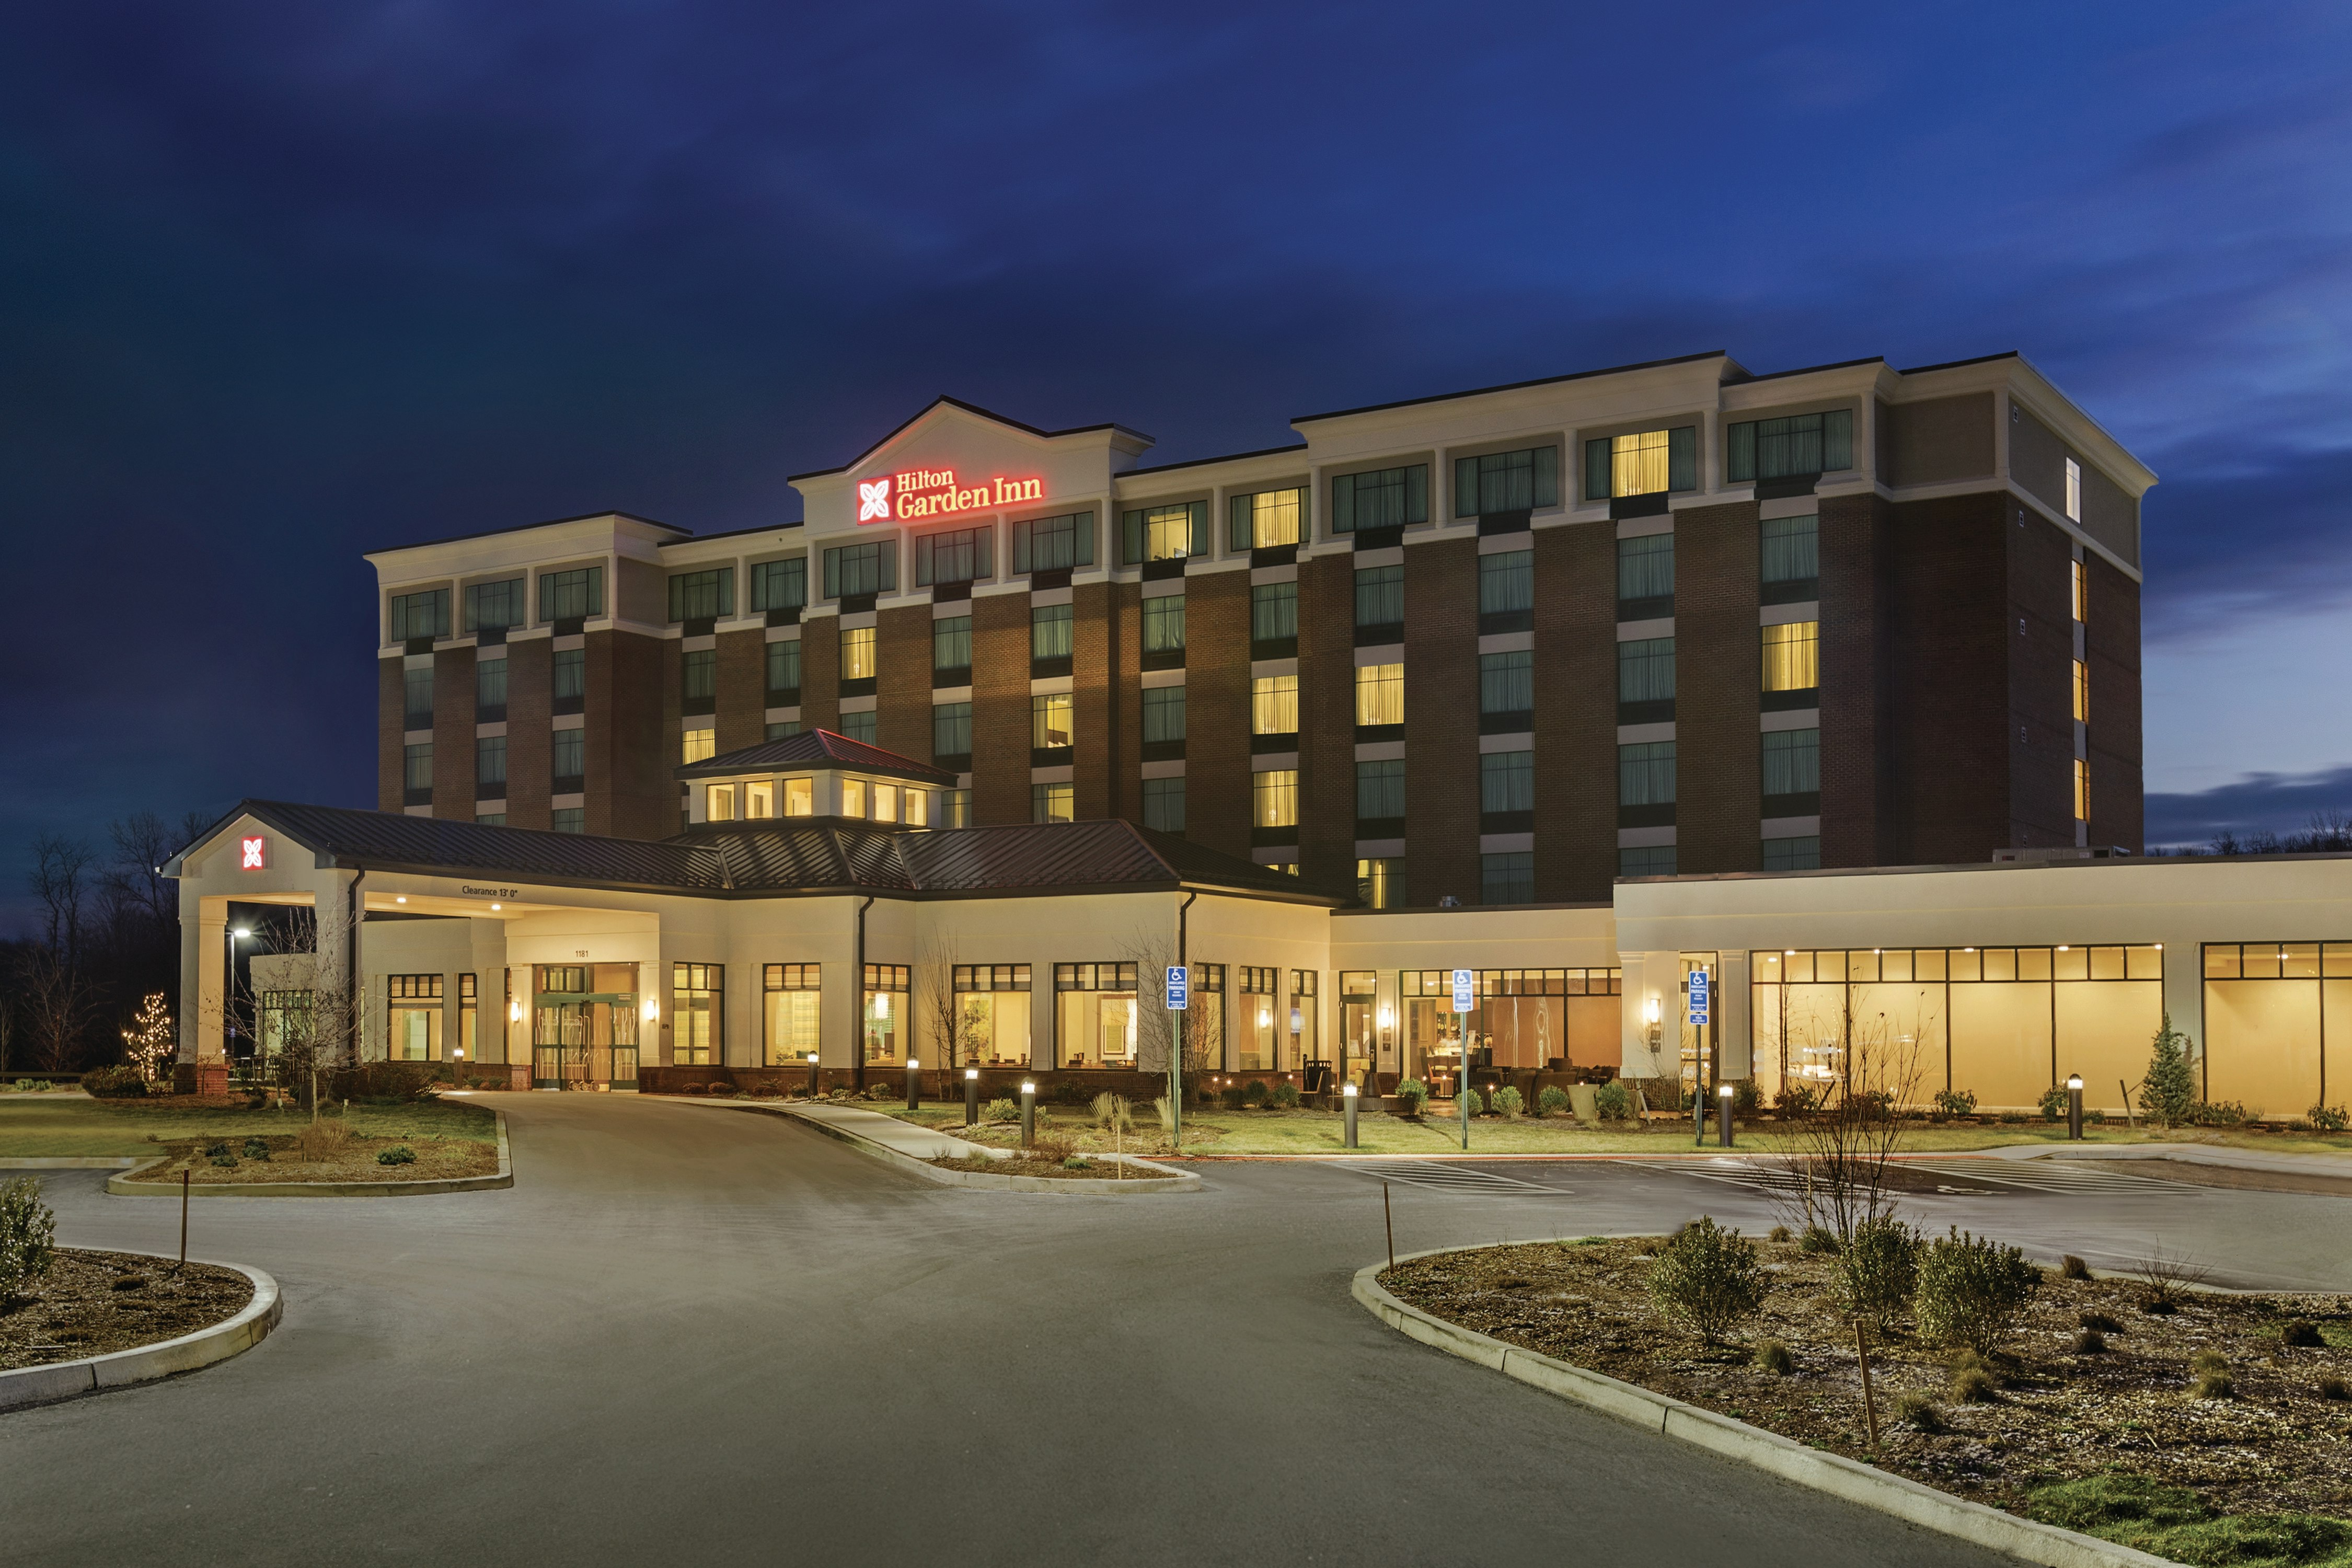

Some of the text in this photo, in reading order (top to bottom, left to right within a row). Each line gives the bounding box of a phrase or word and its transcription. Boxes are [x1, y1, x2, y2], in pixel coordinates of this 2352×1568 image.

[896, 470, 954, 493] Hilton
[896, 477, 1042, 519] Garden Inn
[462, 885, 497, 896] Clearance
[499, 889, 508, 897] 13'
